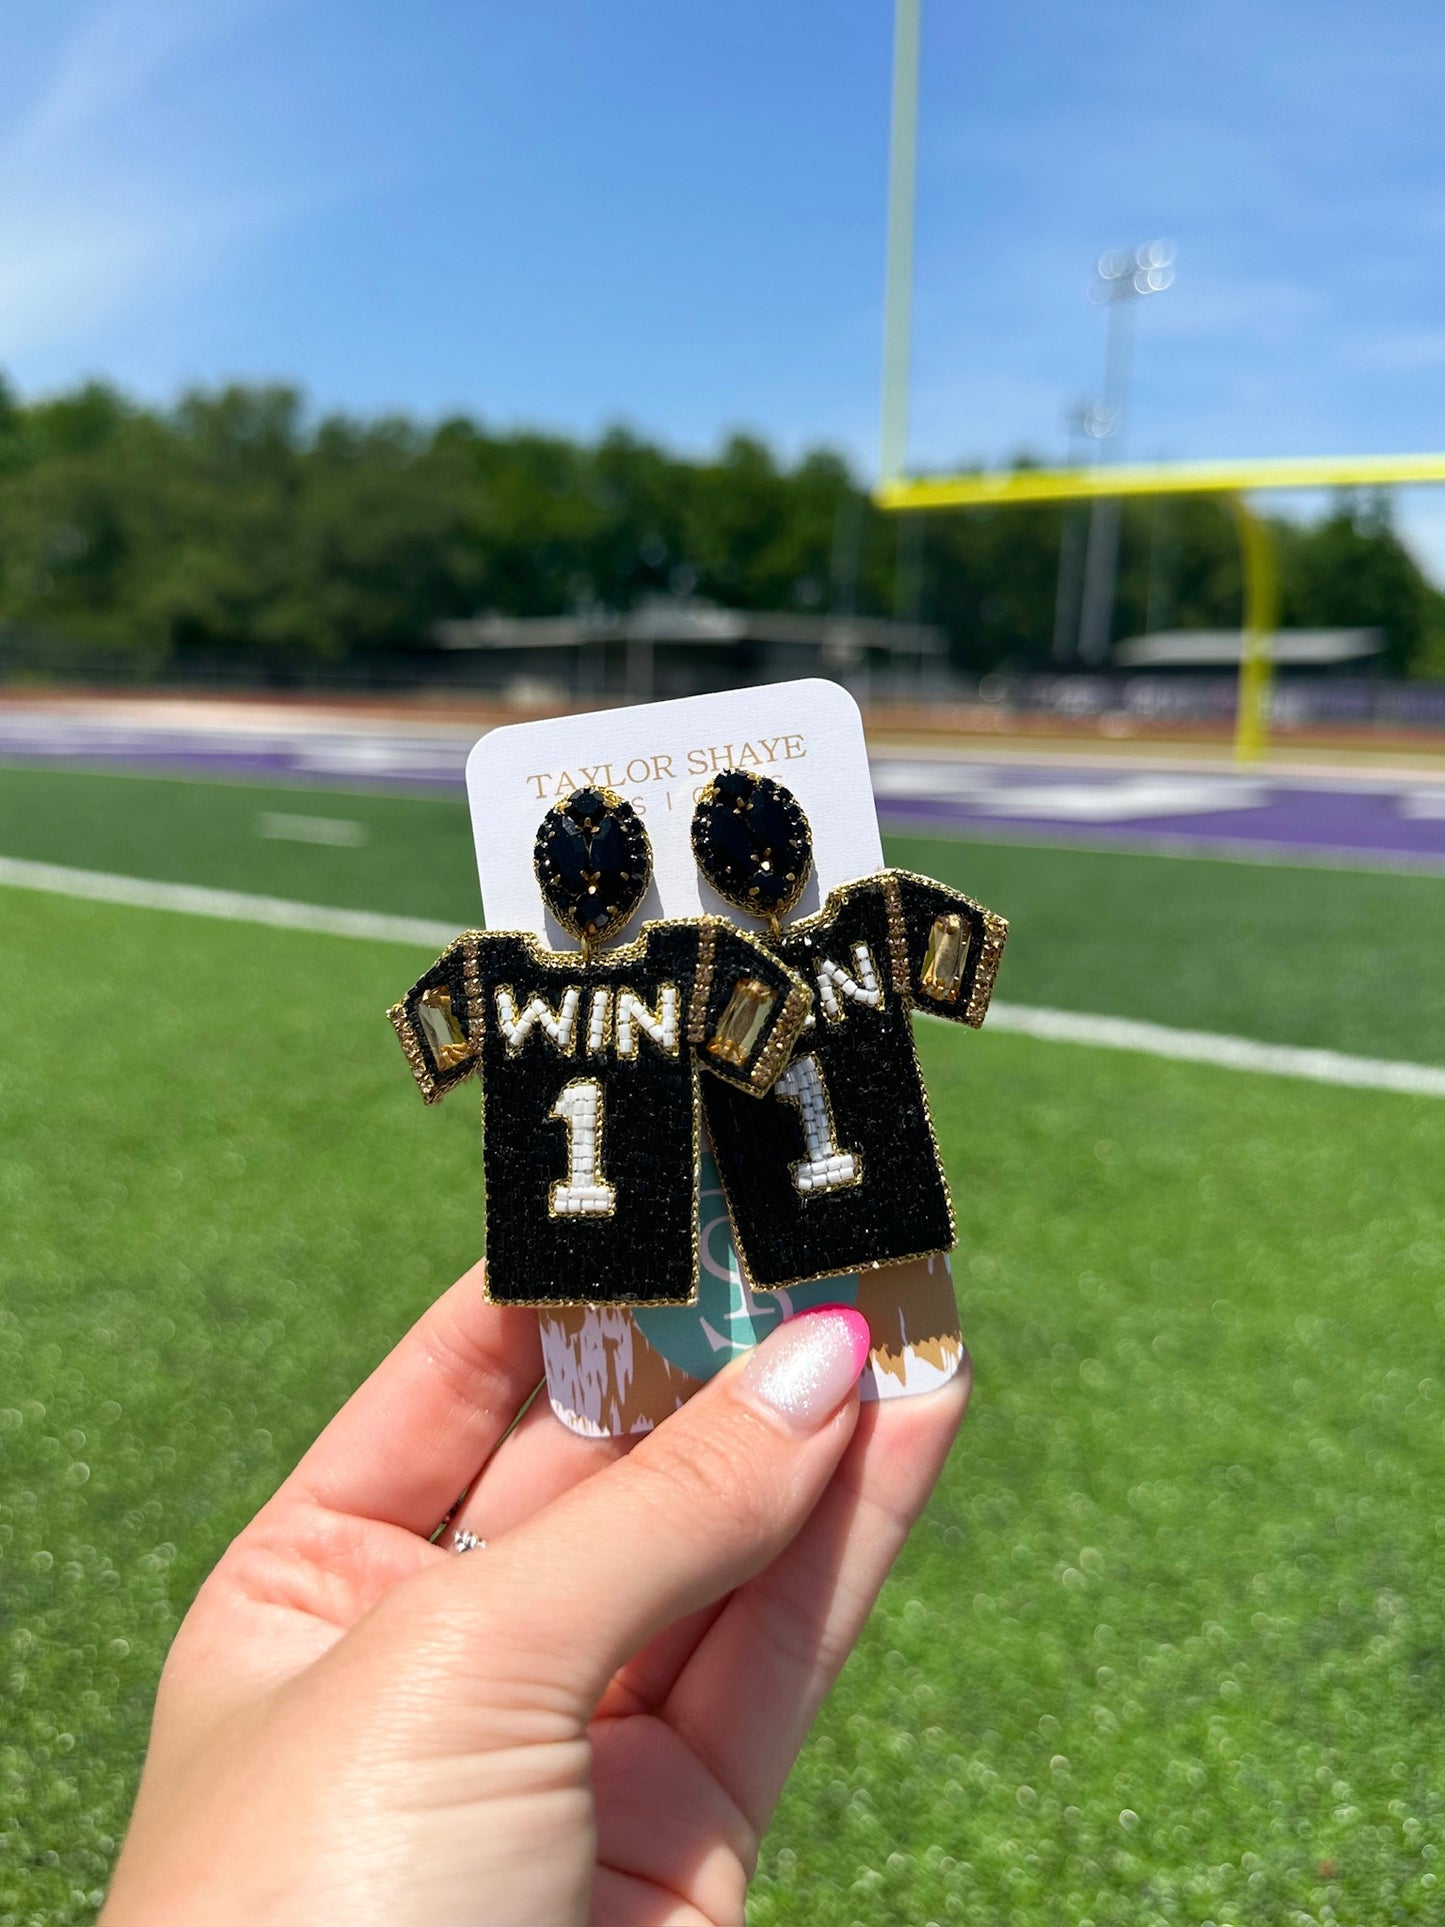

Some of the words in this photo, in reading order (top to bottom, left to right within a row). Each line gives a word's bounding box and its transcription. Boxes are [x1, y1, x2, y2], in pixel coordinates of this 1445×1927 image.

[526, 754, 677, 800] TAYLOR
[686, 734, 808, 776] SHAYE
[494, 984, 681, 1059] WIN
[548, 1077, 617, 1219] 1
[775, 1052, 863, 1197] 1
